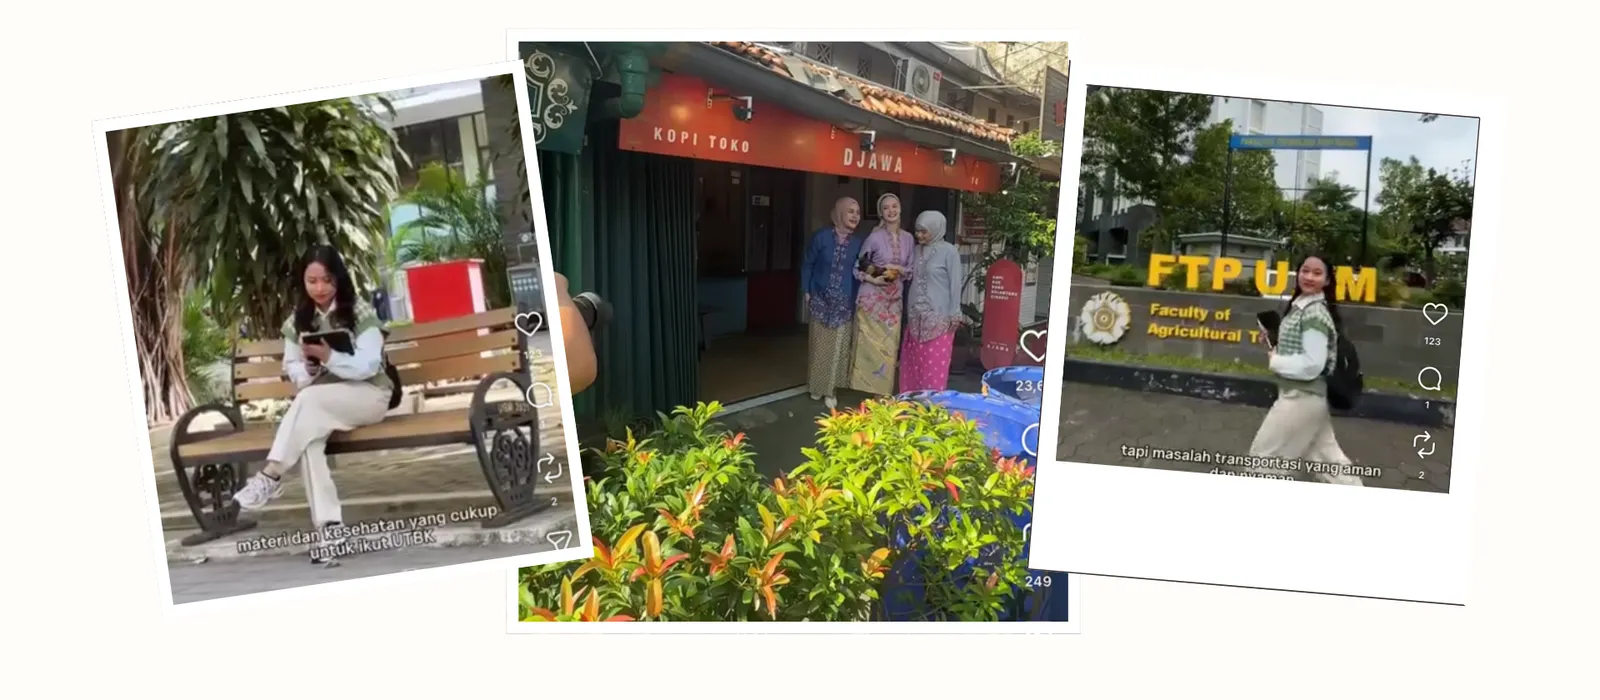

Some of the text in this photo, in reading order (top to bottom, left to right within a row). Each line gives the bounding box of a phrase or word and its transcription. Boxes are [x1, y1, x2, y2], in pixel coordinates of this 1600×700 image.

[654, 126, 903, 174] KOPI TOKO DJAWA
[1147, 252, 1377, 303] FTP UM
[1150, 303, 1232, 321] Faculty of
[1147, 323, 1242, 343] Agricultural
